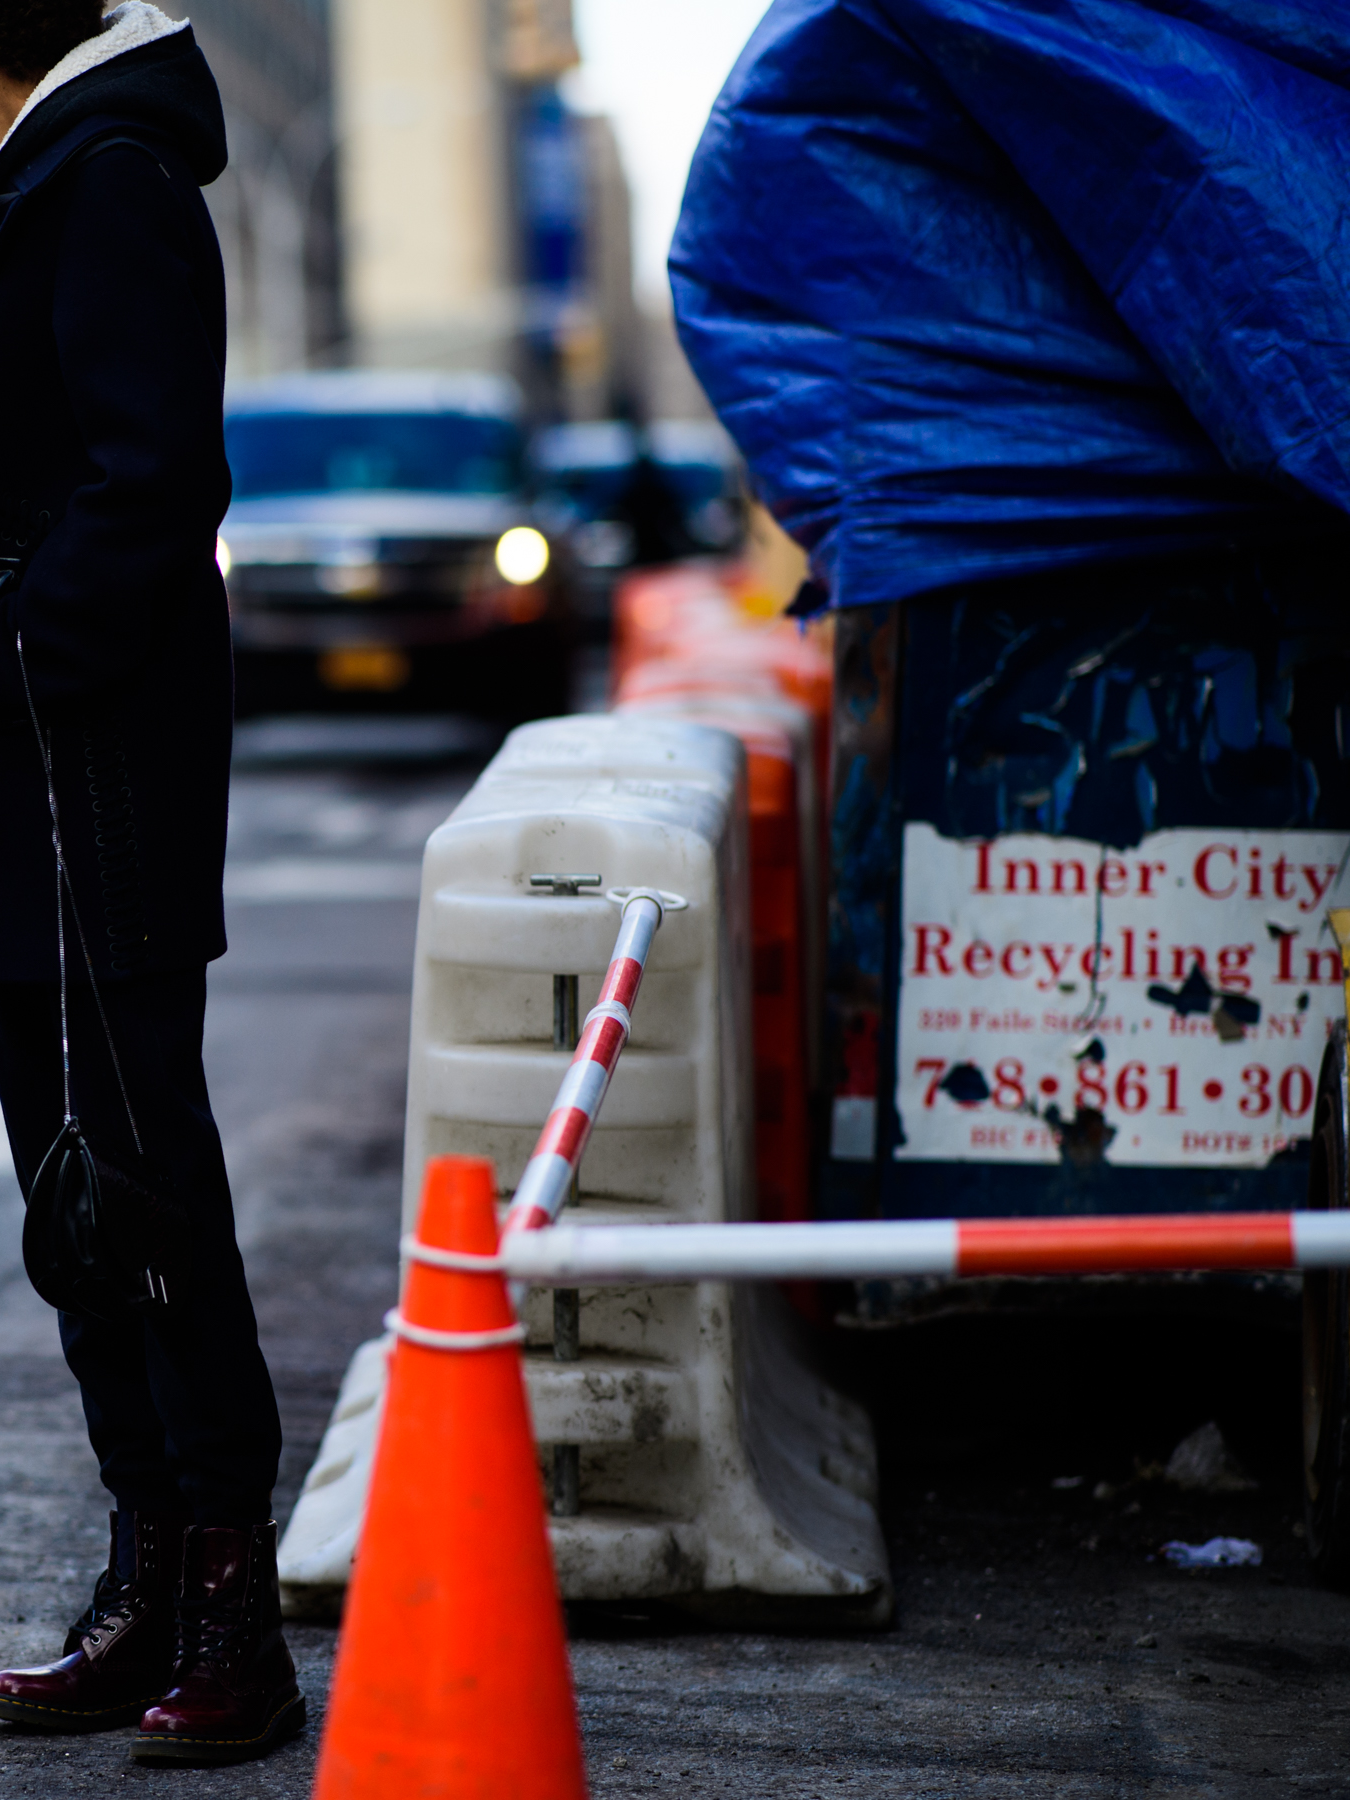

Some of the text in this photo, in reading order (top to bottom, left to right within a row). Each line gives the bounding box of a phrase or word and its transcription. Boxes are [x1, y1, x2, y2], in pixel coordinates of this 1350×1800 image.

[971, 842, 1338, 914] Inner City
[910, 921, 1255, 993] Recycling
[1041, 1007, 1124, 1036] Street
[1267, 1014, 1306, 1040] NY
